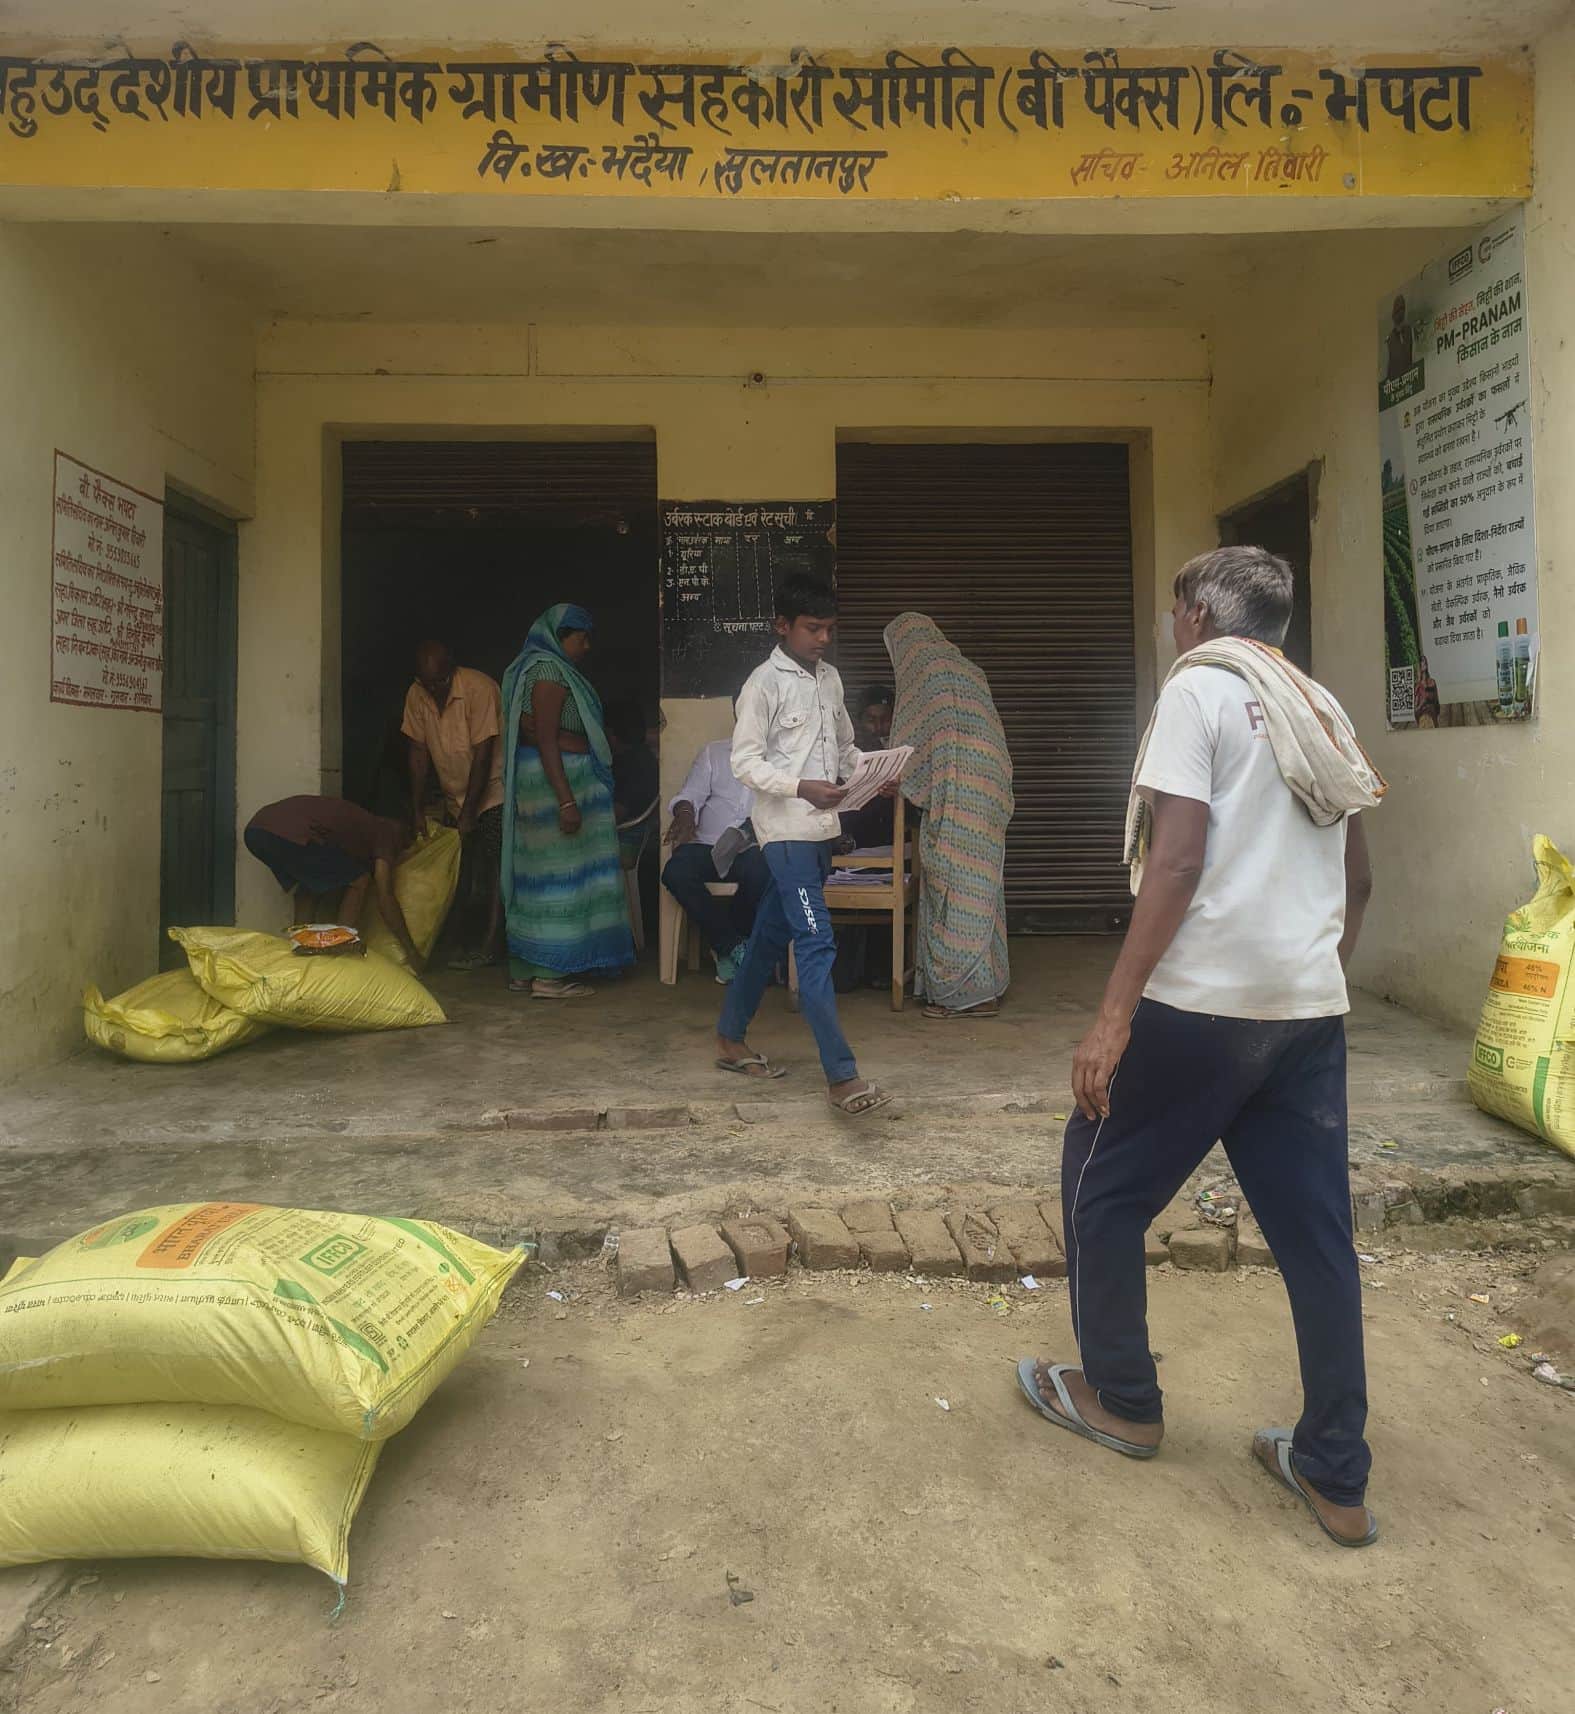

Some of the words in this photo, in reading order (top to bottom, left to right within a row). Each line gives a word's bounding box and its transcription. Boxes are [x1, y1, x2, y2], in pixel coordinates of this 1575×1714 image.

[446, 42, 634, 126] ग्रामीण
[833, 47, 995, 133] समिति
[1165, 145, 1249, 182] अनिल
[1253, 143, 1328, 182] तिवारी
[1437, 290, 1520, 354] PM-PRANAM
[1457, 335, 1487, 364] किसान
[1489, 326, 1499, 346] के
[1501, 318, 1522, 340] नाम
[1459, 493, 1473, 505] 50%
